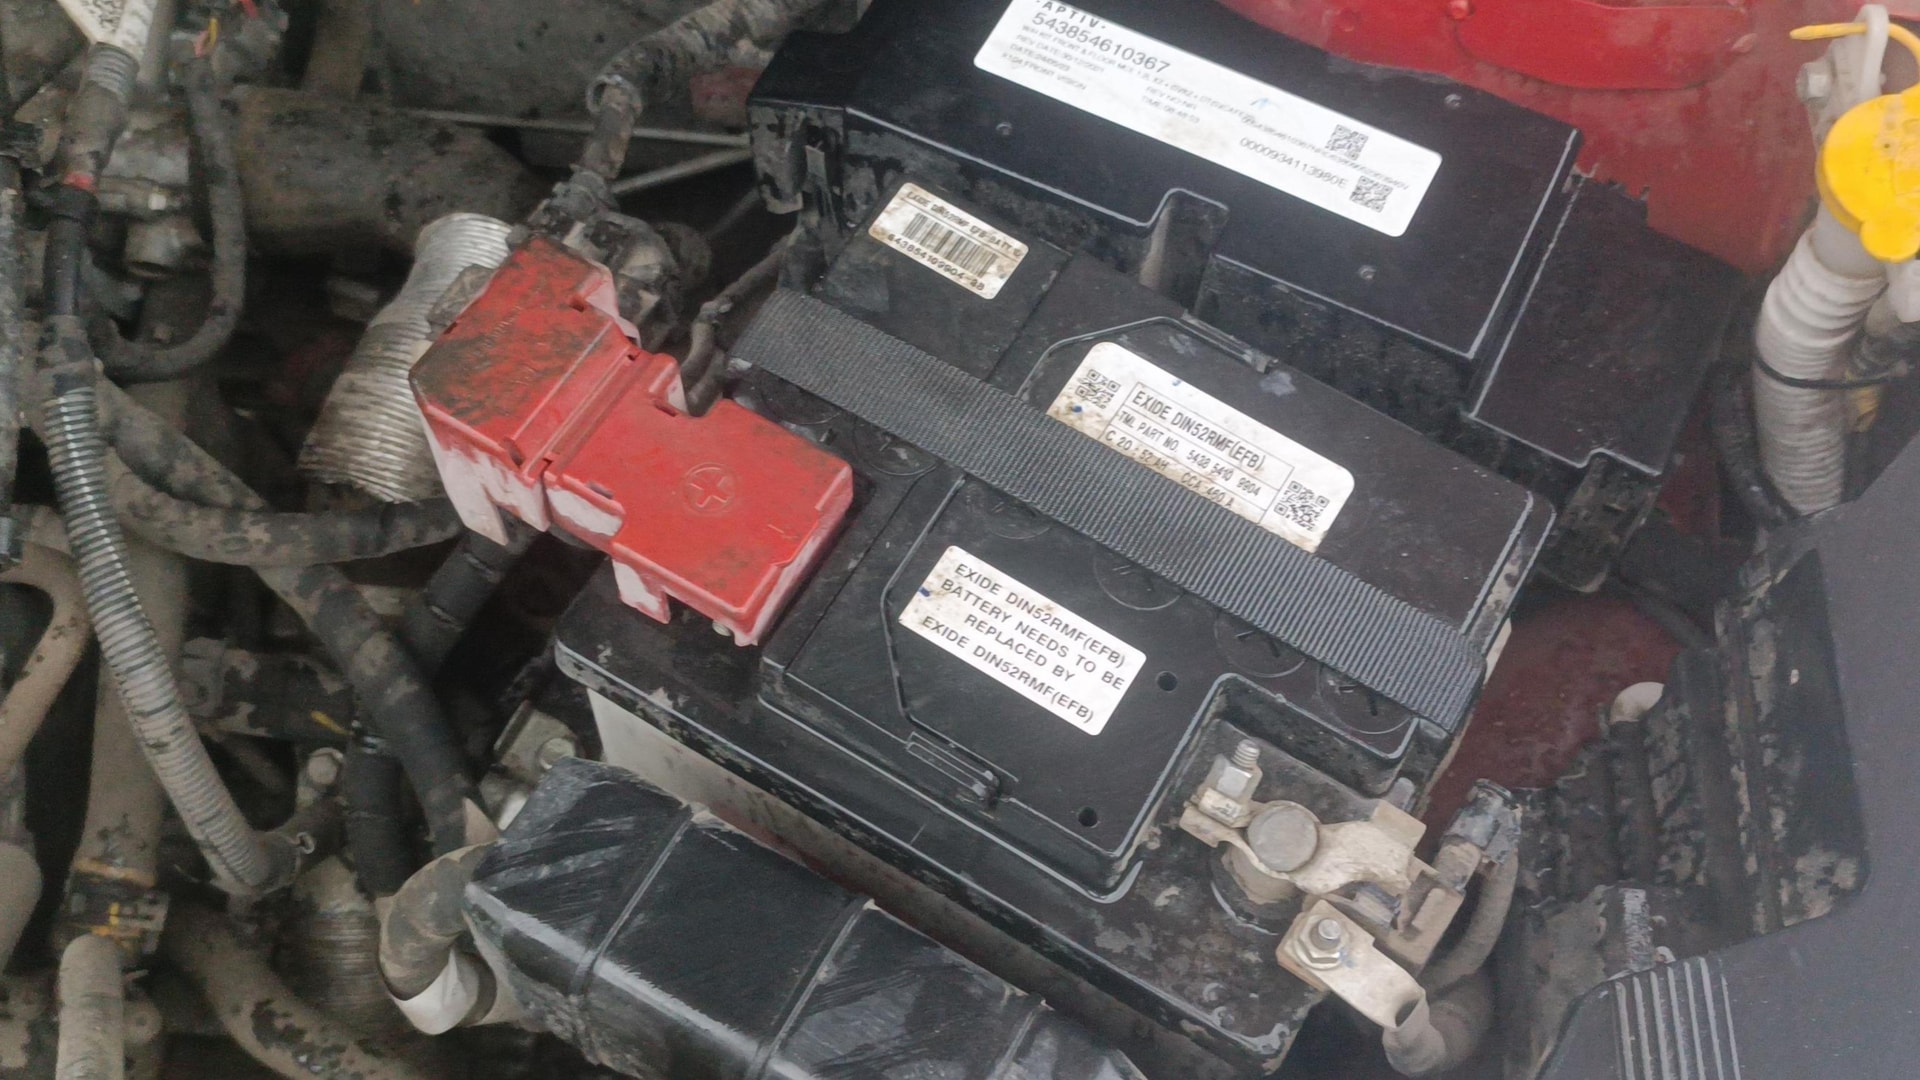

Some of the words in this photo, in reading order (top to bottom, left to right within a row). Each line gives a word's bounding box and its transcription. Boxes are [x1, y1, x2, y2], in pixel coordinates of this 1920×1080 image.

[1032, 12, 1170, 73] 543854610367
[1105, 430, 1116, 443] C
[1117, 435, 1134, 452] 20
[1118, 411, 1136, 430] TML
[1137, 422, 1164, 442] PART
[1132, 390, 1173, 421] EXIDE
[1170, 411, 1267, 472] DIN52RMF(EFB)
[940, 578, 1013, 624] BATTERY
[1014, 620, 1070, 659] NEEDS
[1074, 654, 1097, 674] TO
[1101, 674, 1126, 691] BE
[954, 563, 1002, 595] EXIDE
[1004, 592, 1127, 669] DIN52RMF(EFB)
[963, 613, 1048, 667] REPLACED
[1051, 664, 1076, 683] BY
[922, 615, 970, 649] EXIDE
[972, 644, 1095, 724] DIN52RMF(EFB)
